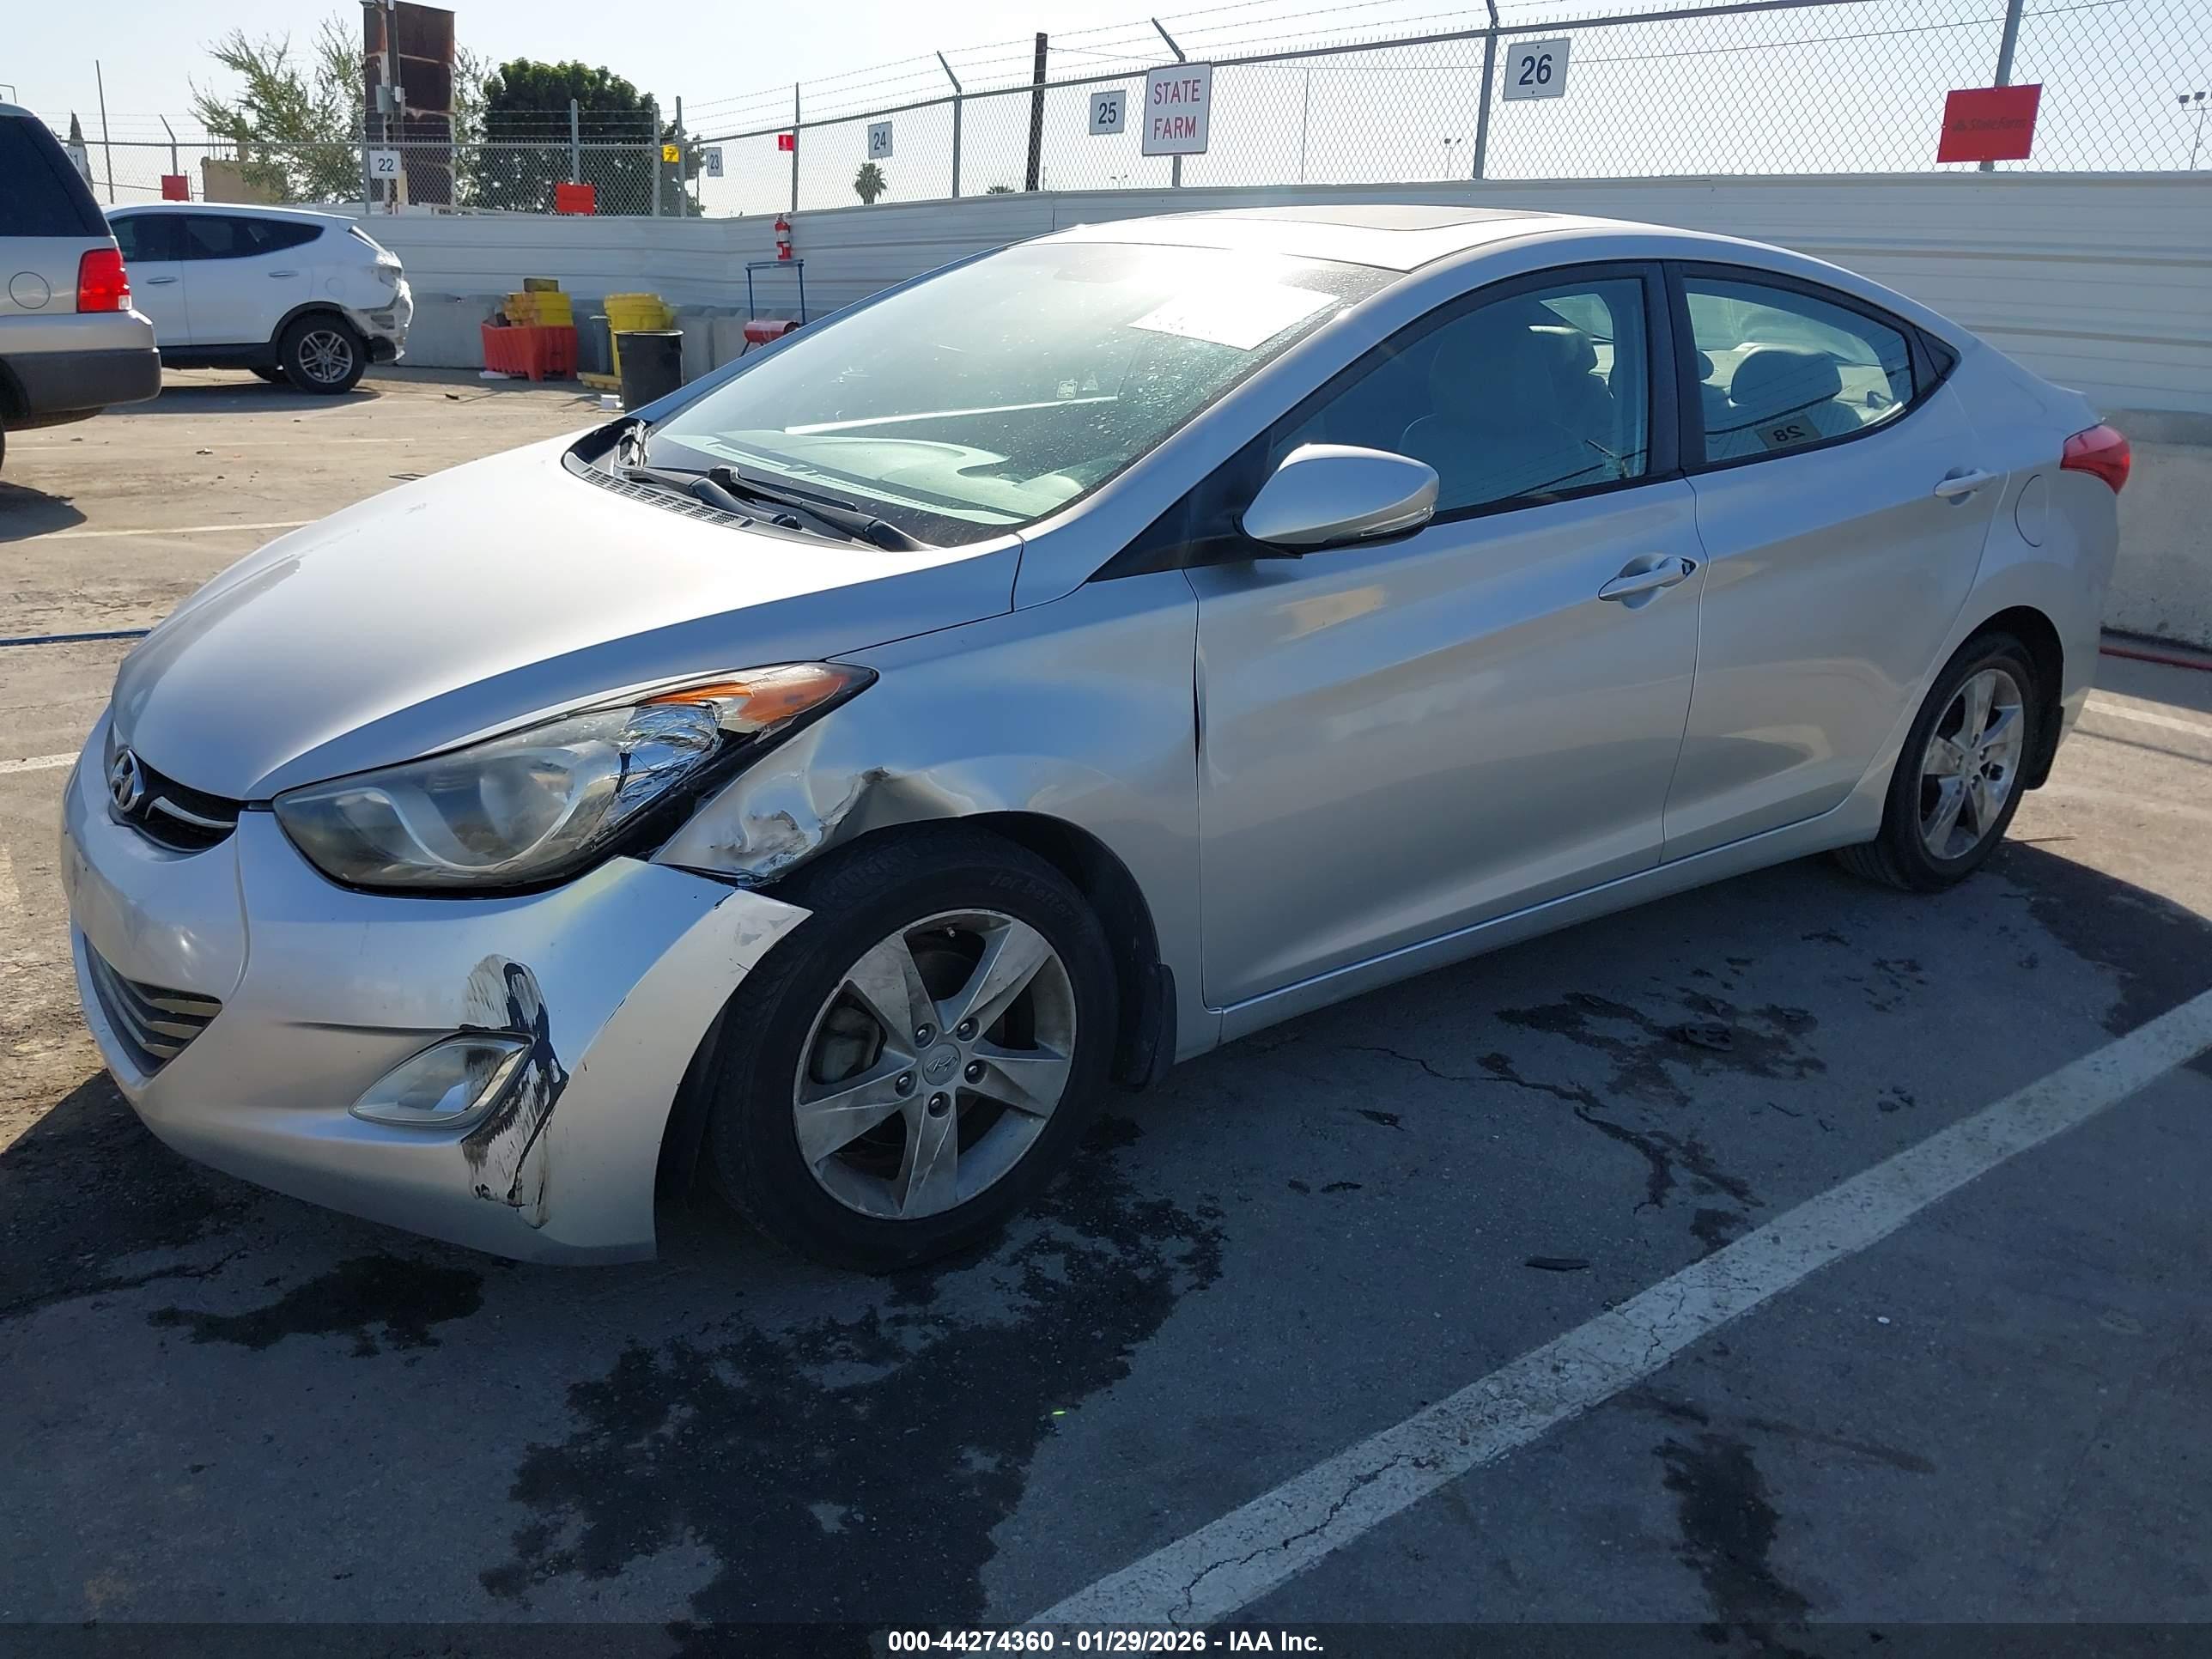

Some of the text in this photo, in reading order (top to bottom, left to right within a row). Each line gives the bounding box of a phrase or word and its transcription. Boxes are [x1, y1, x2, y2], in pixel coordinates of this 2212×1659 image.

[1518, 53, 1553, 86] 26
[1153, 78, 1201, 105] STATE
[1097, 101, 1117, 125] 25
[1153, 115, 1197, 140] FARM
[873, 131, 887, 151] 24
[378, 158, 394, 172] 22
[709, 154, 720, 170] 23
